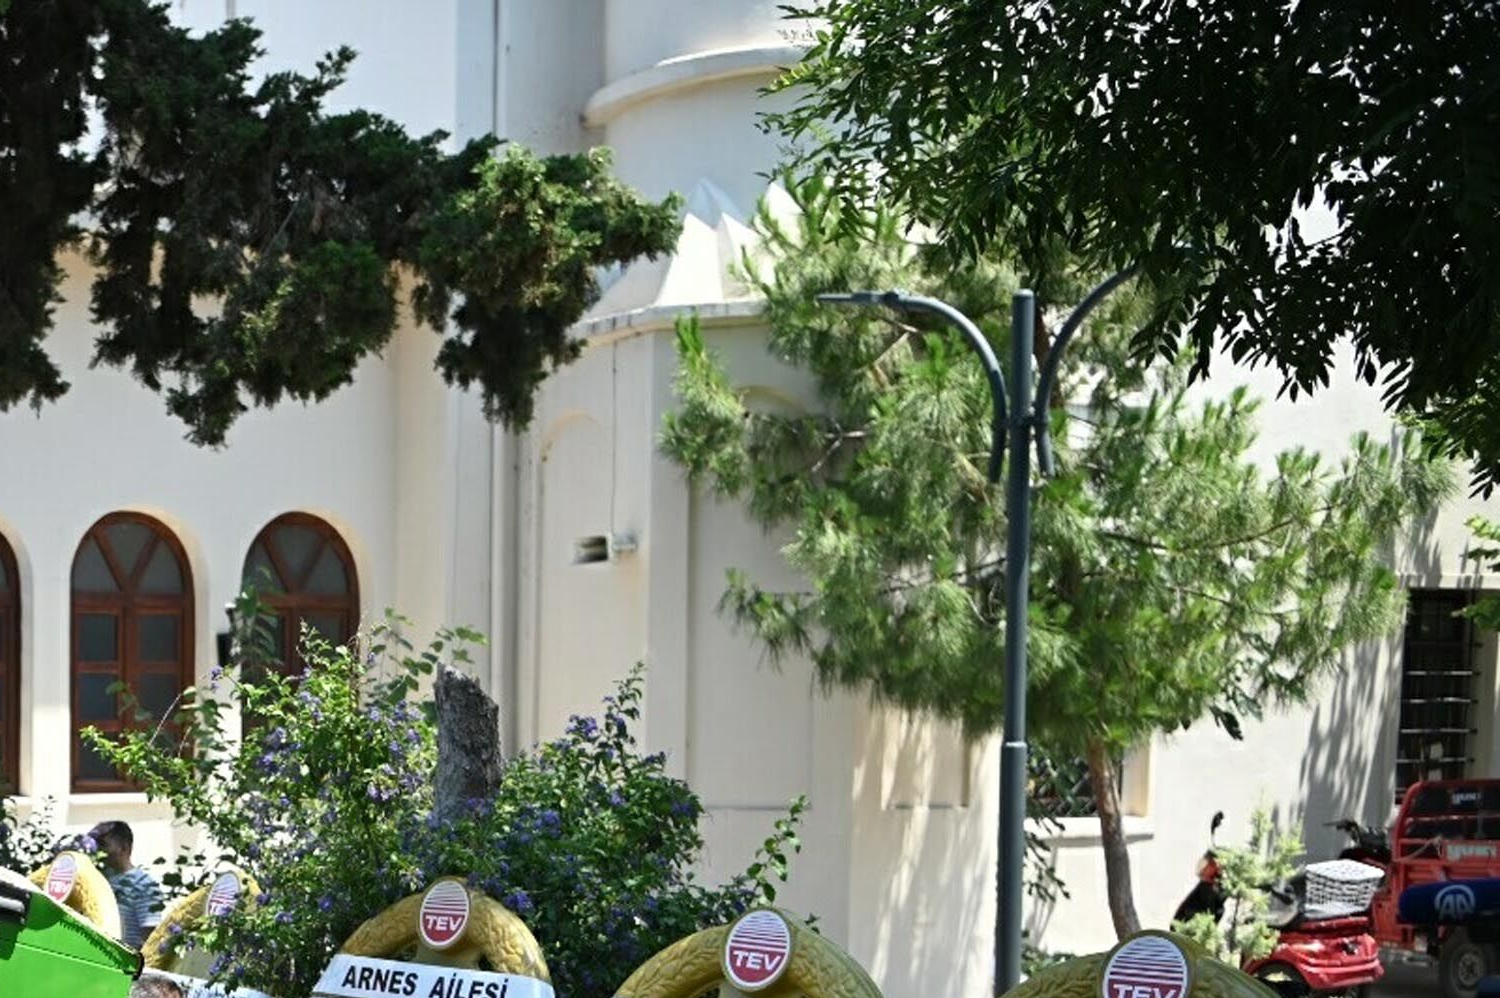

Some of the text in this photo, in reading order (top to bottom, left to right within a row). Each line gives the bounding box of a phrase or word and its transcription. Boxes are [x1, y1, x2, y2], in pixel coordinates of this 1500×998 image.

[425, 914, 462, 932] TEV
[733, 950, 783, 972] TEV
[342, 965, 419, 996] ARNES
